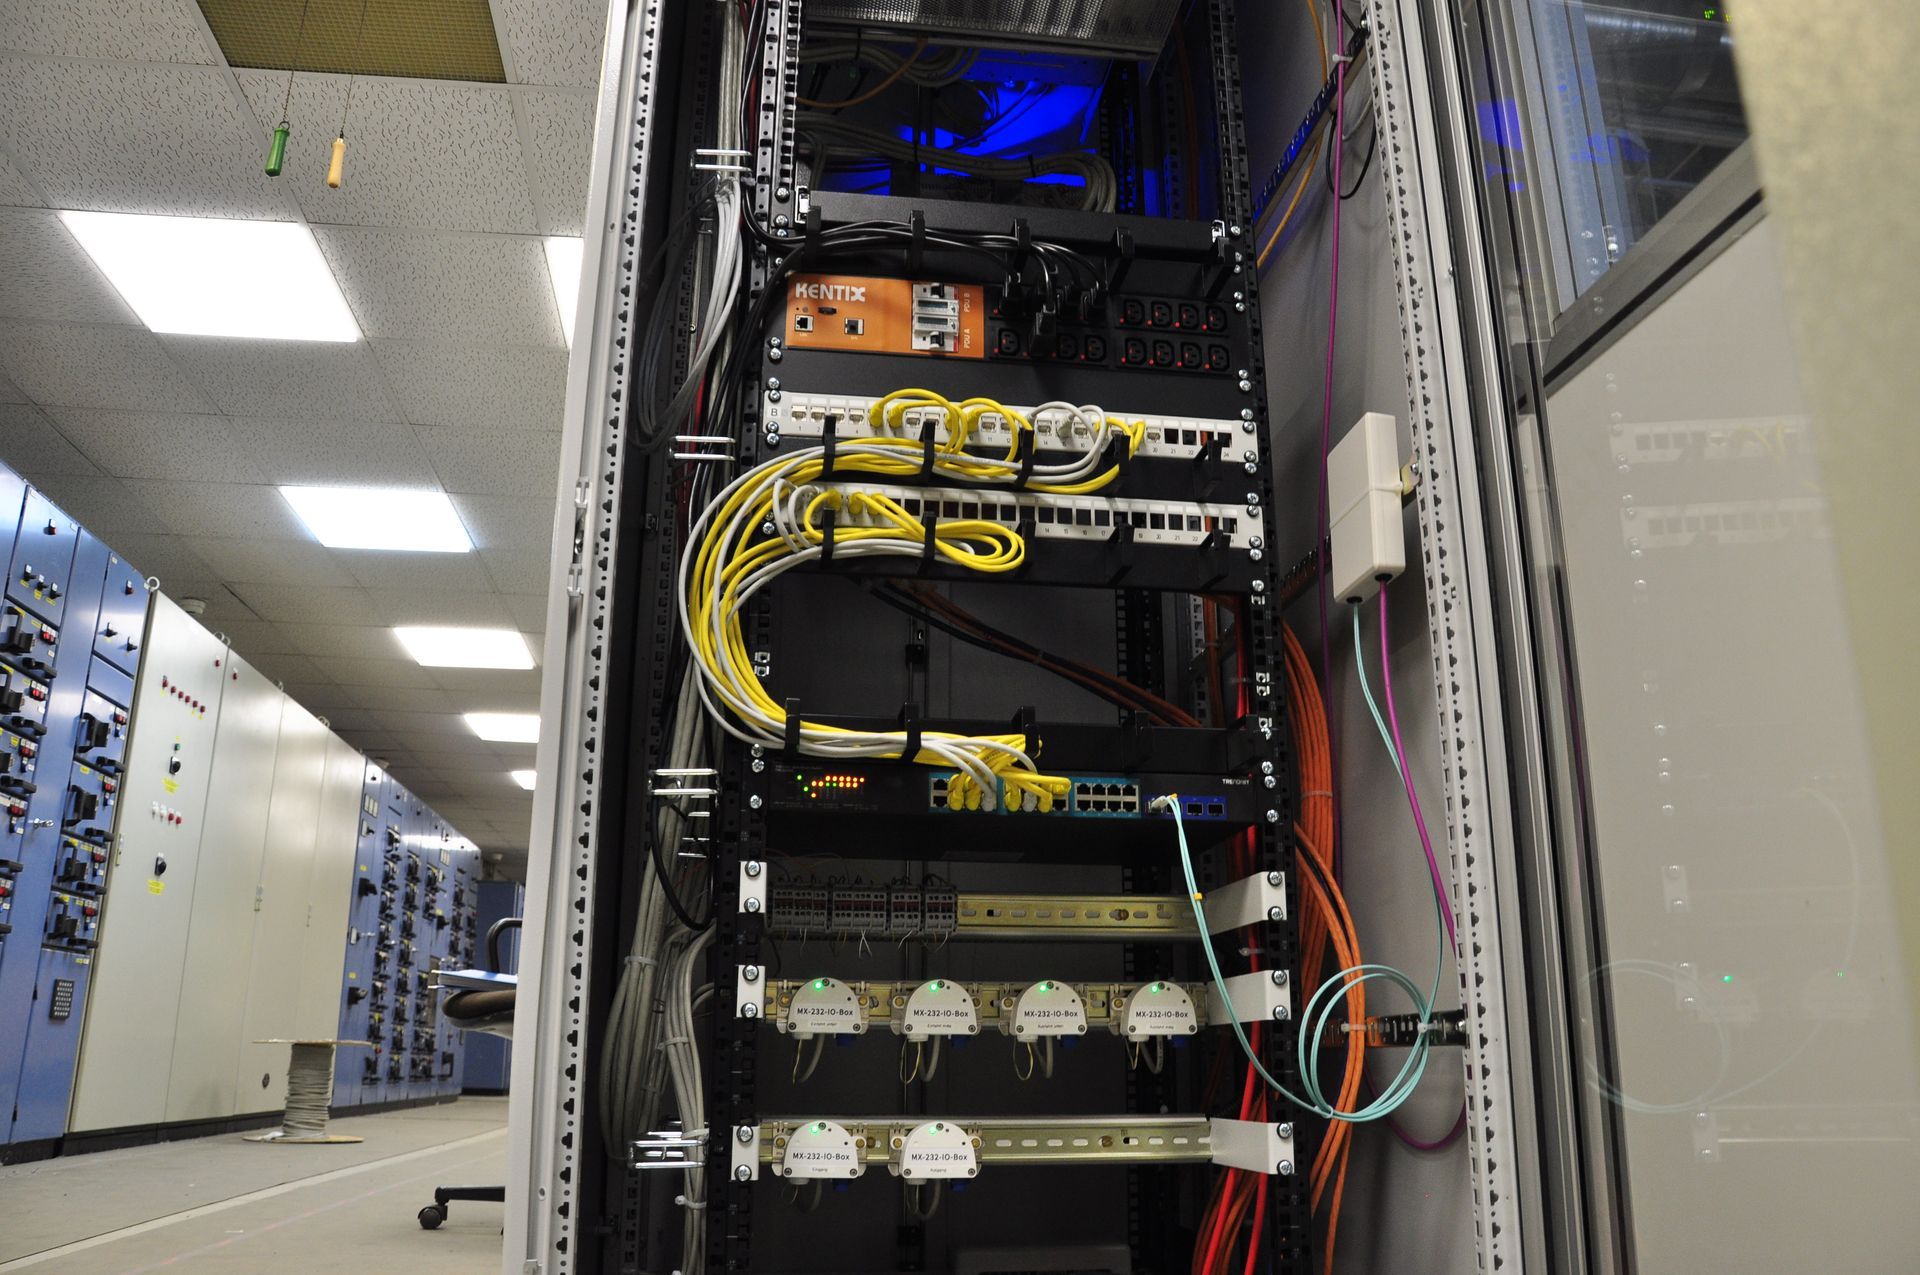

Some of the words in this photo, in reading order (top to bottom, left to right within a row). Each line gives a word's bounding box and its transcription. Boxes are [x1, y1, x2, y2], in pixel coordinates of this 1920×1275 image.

[795, 282, 866, 302] KENTIX
[963, 297, 971, 313] PDU
[963, 335, 971, 349] PDU
[770, 408, 778, 417] B
[796, 1007, 854, 1016] MX-232-IO-Box
[913, 1009, 969, 1018] MX-232-IO-Box
[1024, 1010, 1079, 1018] MX-232-IO-Box
[1135, 1010, 1189, 1018] MX-232-IO-Box
[792, 1152, 850, 1161] MX-232-IO-Box
[911, 1153, 968, 1161] MX-232-IO-Box
